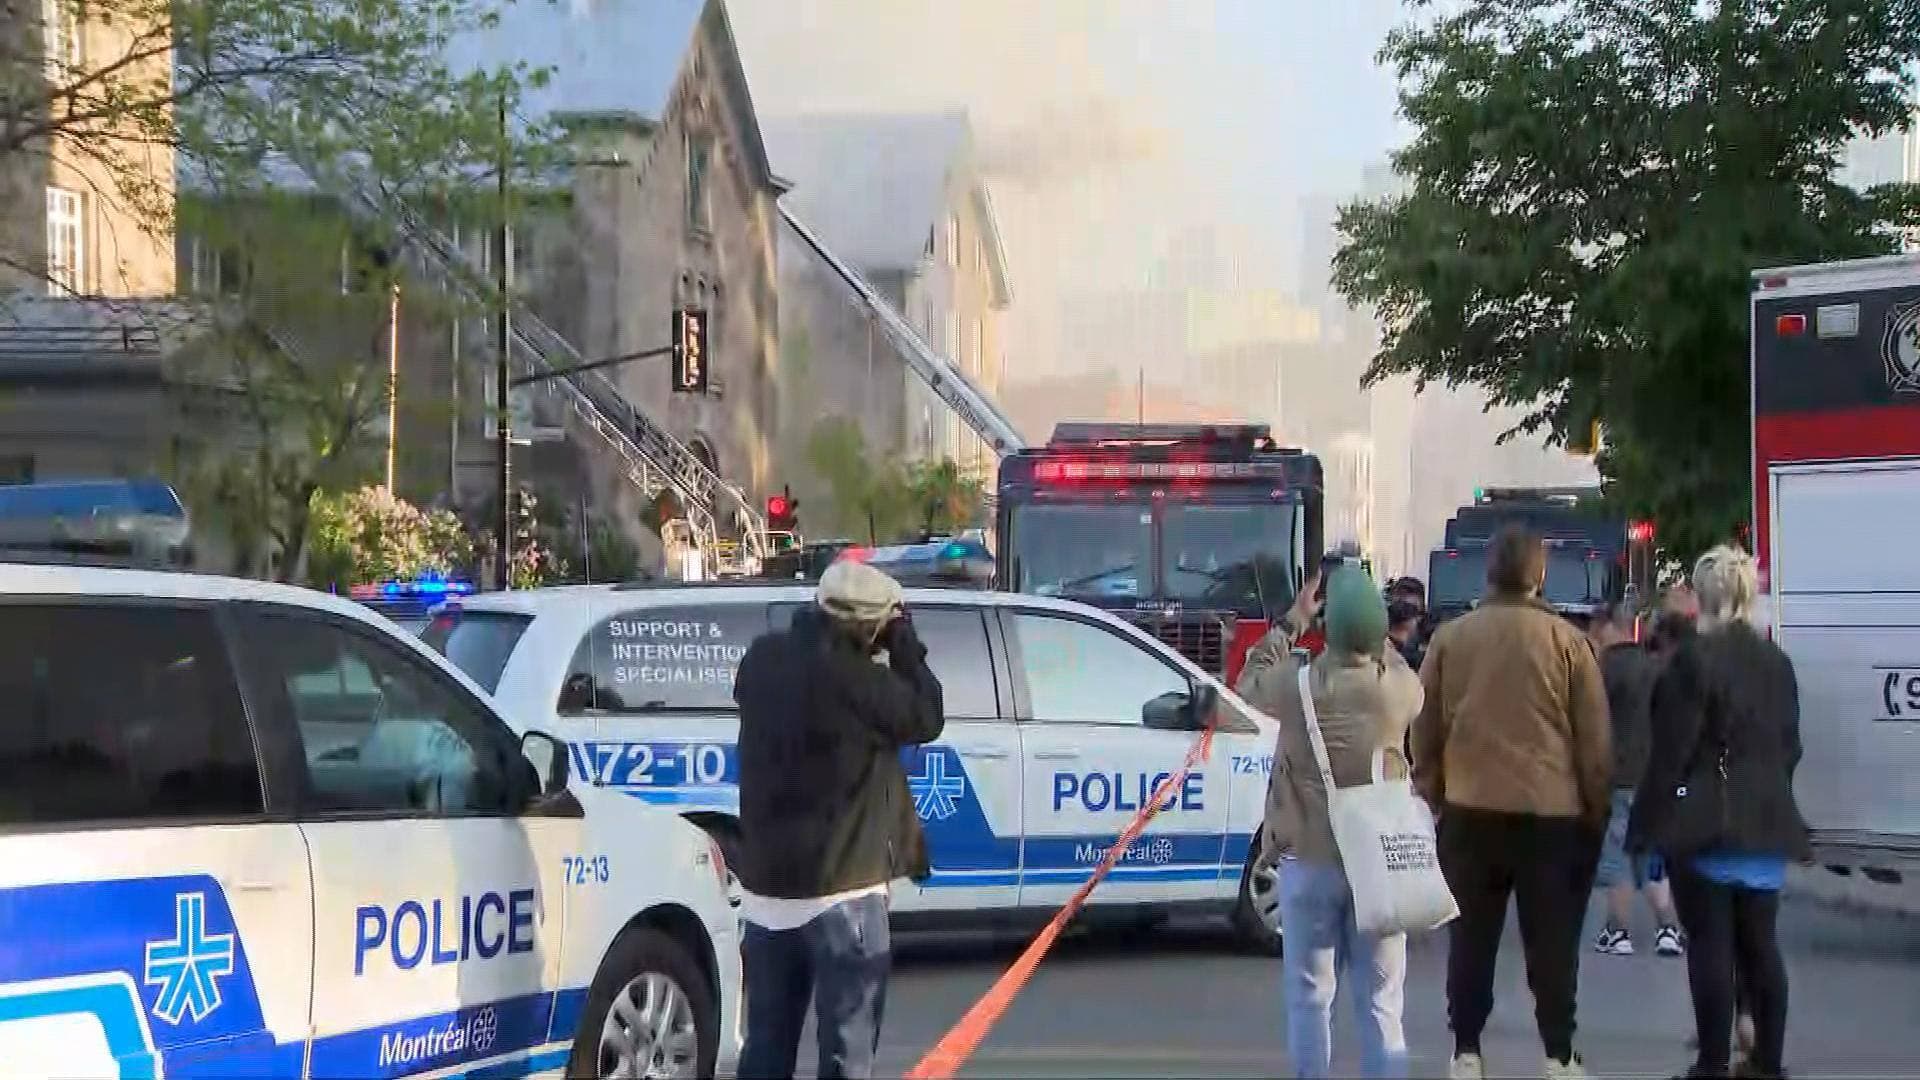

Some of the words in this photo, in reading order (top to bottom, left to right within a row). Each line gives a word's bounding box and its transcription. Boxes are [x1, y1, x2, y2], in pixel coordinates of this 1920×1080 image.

[609, 621, 701, 637] SUPPORT
[709, 623, 722, 637] &
[612, 643, 748, 661] INTERVENTIO
[598, 744, 726, 783] 72-10
[1053, 772, 1204, 812] POLICE
[563, 855, 609, 884] 72-13
[354, 889, 535, 975] POLICE
[378, 1017, 472, 1067] Montréal
